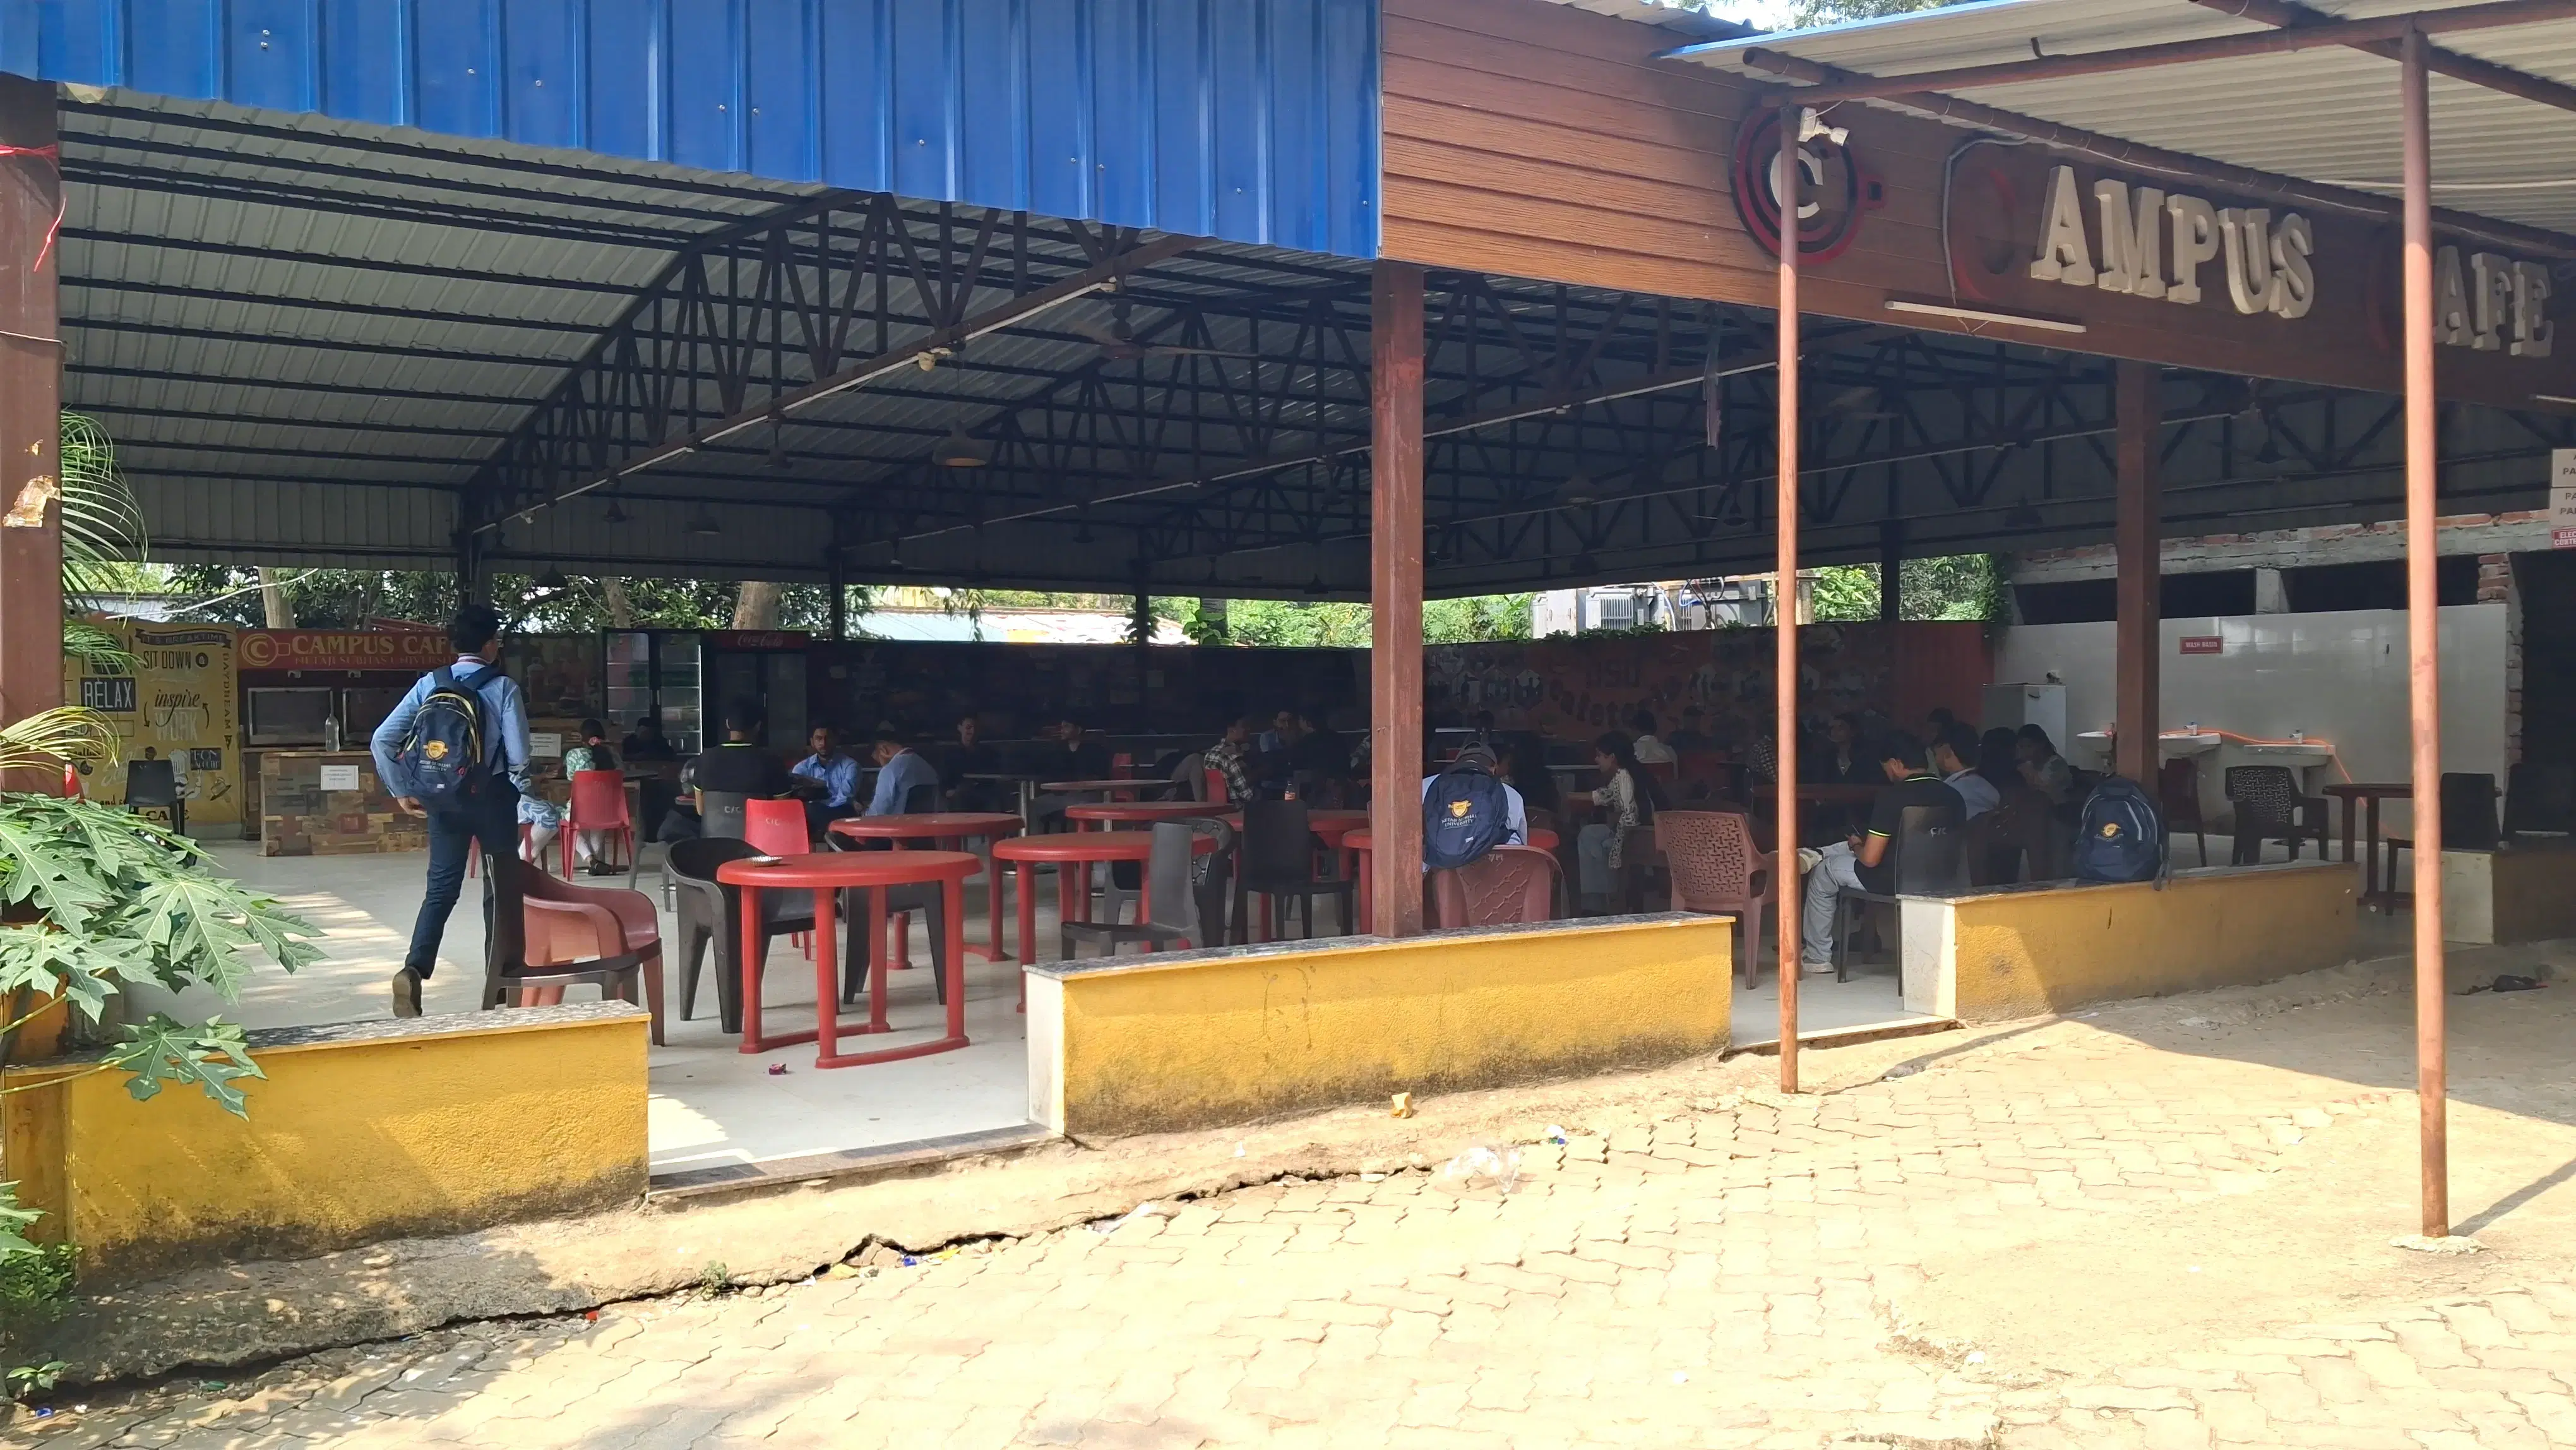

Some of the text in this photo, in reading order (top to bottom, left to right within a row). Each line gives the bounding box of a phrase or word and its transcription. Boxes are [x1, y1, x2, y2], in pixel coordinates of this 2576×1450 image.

[292, 635, 395, 654] CAMPUS
[143, 650, 158, 669] SIT
[162, 651, 191, 670] DOWN
[84, 681, 132, 709] RELAX
[222, 652, 231, 729] DAYDREAM
[155, 712, 198, 742] WORK
